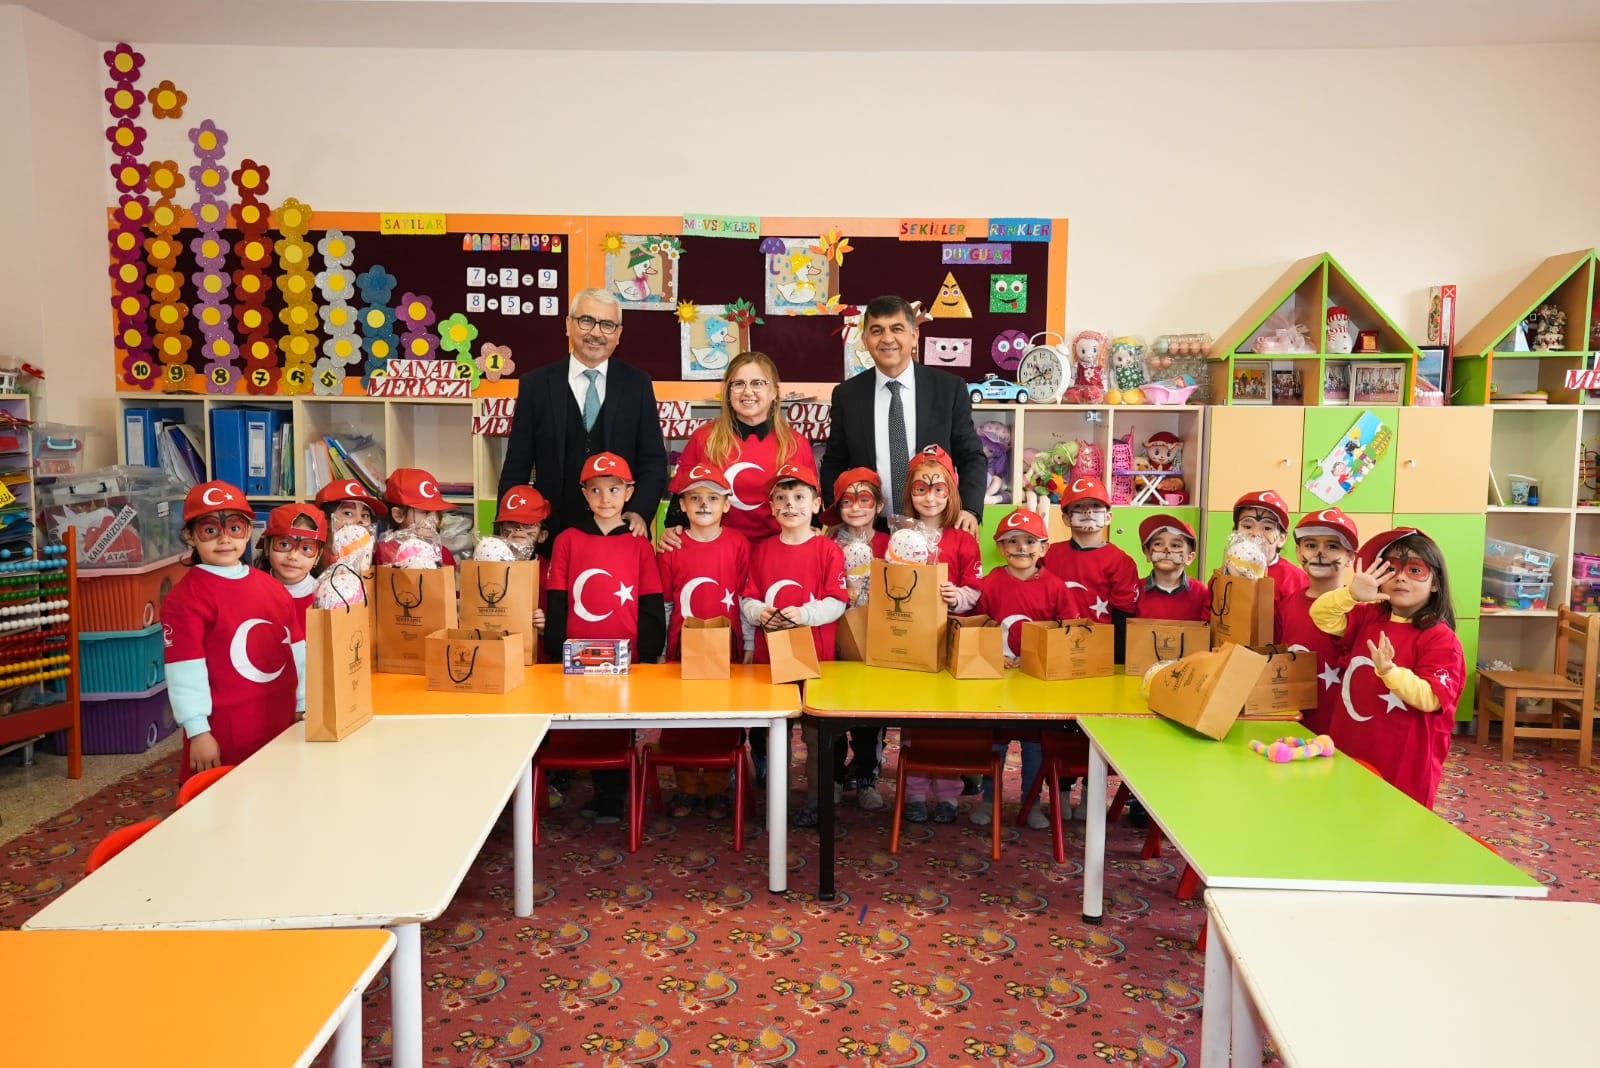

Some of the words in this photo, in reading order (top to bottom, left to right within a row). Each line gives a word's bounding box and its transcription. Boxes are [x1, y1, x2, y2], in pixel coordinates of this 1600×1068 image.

[384, 219, 444, 230] SAYILAR
[943, 248, 1011, 261] DUYGULAR
[474, 269, 481, 280] 7
[506, 270, 513, 281] 2
[543, 271, 551, 282] 9
[473, 296, 480, 306] 8
[508, 297, 515, 307] 5
[546, 298, 553, 309] 3
[387, 359, 458, 378] SANAT
[491, 354, 500, 369] 1
[134, 364, 148, 376] 10
[172, 366, 182, 380] 9
[215, 368, 227, 383] 8
[457, 365, 472, 379] 2
[255, 371, 266, 385] 7
[320, 371, 336, 387] 5
